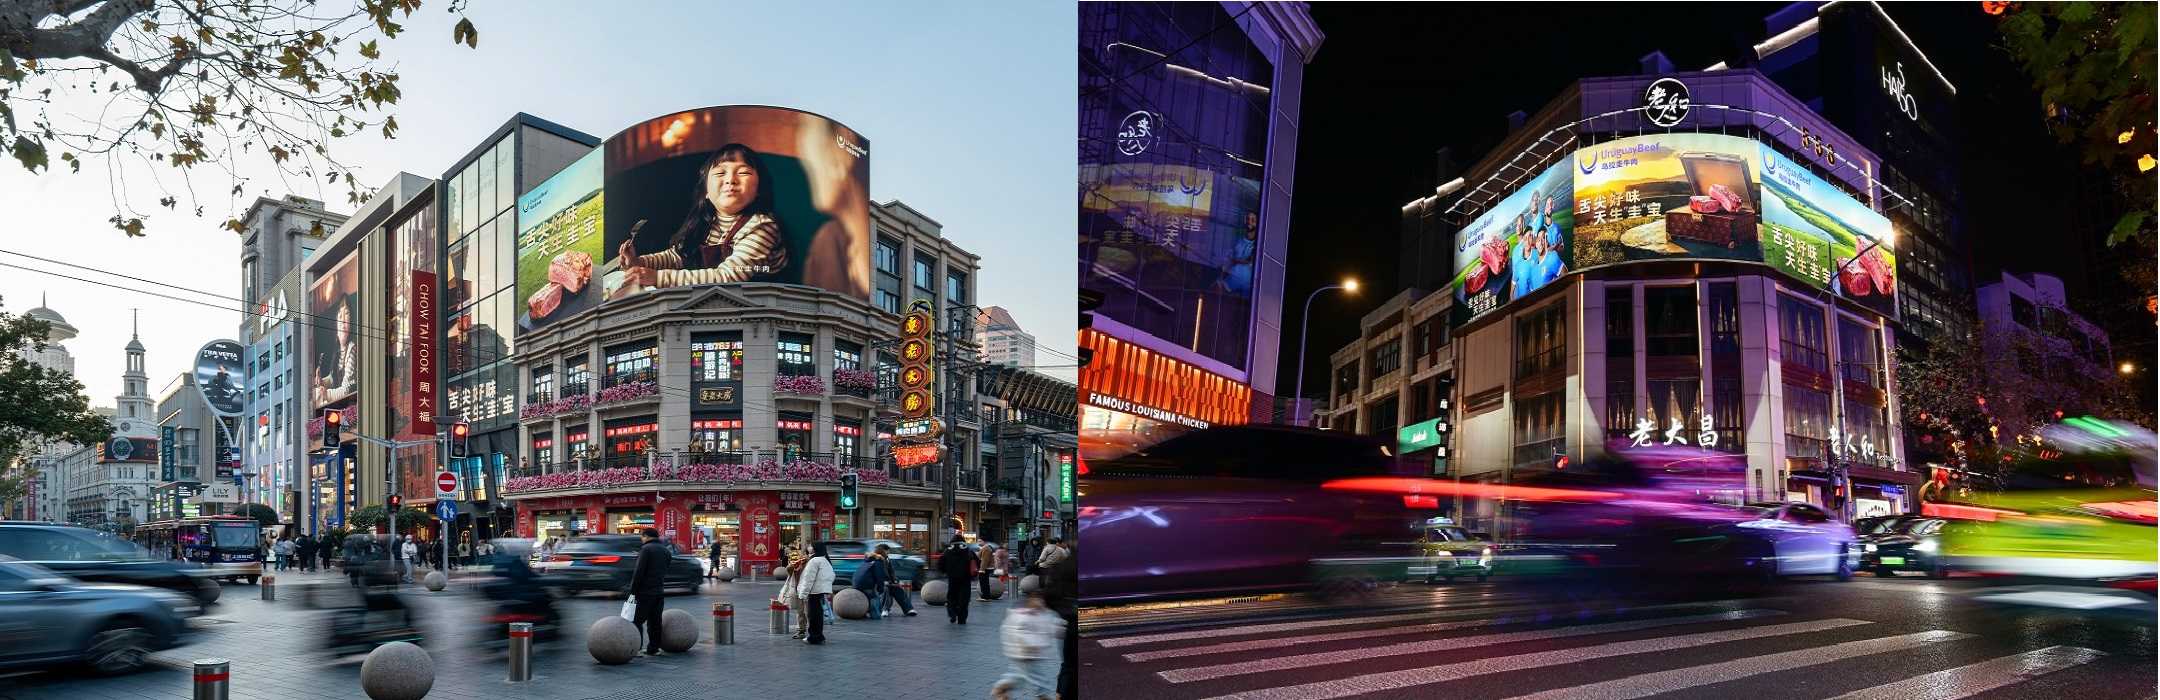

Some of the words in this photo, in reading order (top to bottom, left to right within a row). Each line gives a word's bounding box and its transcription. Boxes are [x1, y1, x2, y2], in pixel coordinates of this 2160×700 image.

[1601, 142, 1660, 160] UruguayBeef
[1579, 190, 1640, 214] 舌尖好味
[526, 205, 578, 247] 舌尖好味
[1772, 226, 1818, 262] 舌尖好味
[419, 283, 429, 320] CHOW
[418, 323, 429, 340] TAI
[419, 343, 429, 374] FOOK
[418, 381, 431, 423] 周大福
[448, 380, 496, 410] 舌尖好味
[1089, 393, 1130, 411] FAMOUS
[1132, 404, 1176, 423] LOUISIANA
[1177, 415, 1209, 430] CHICKEN
[1629, 414, 1719, 448] 老大昌
[1828, 425, 1875, 460] 老人和
